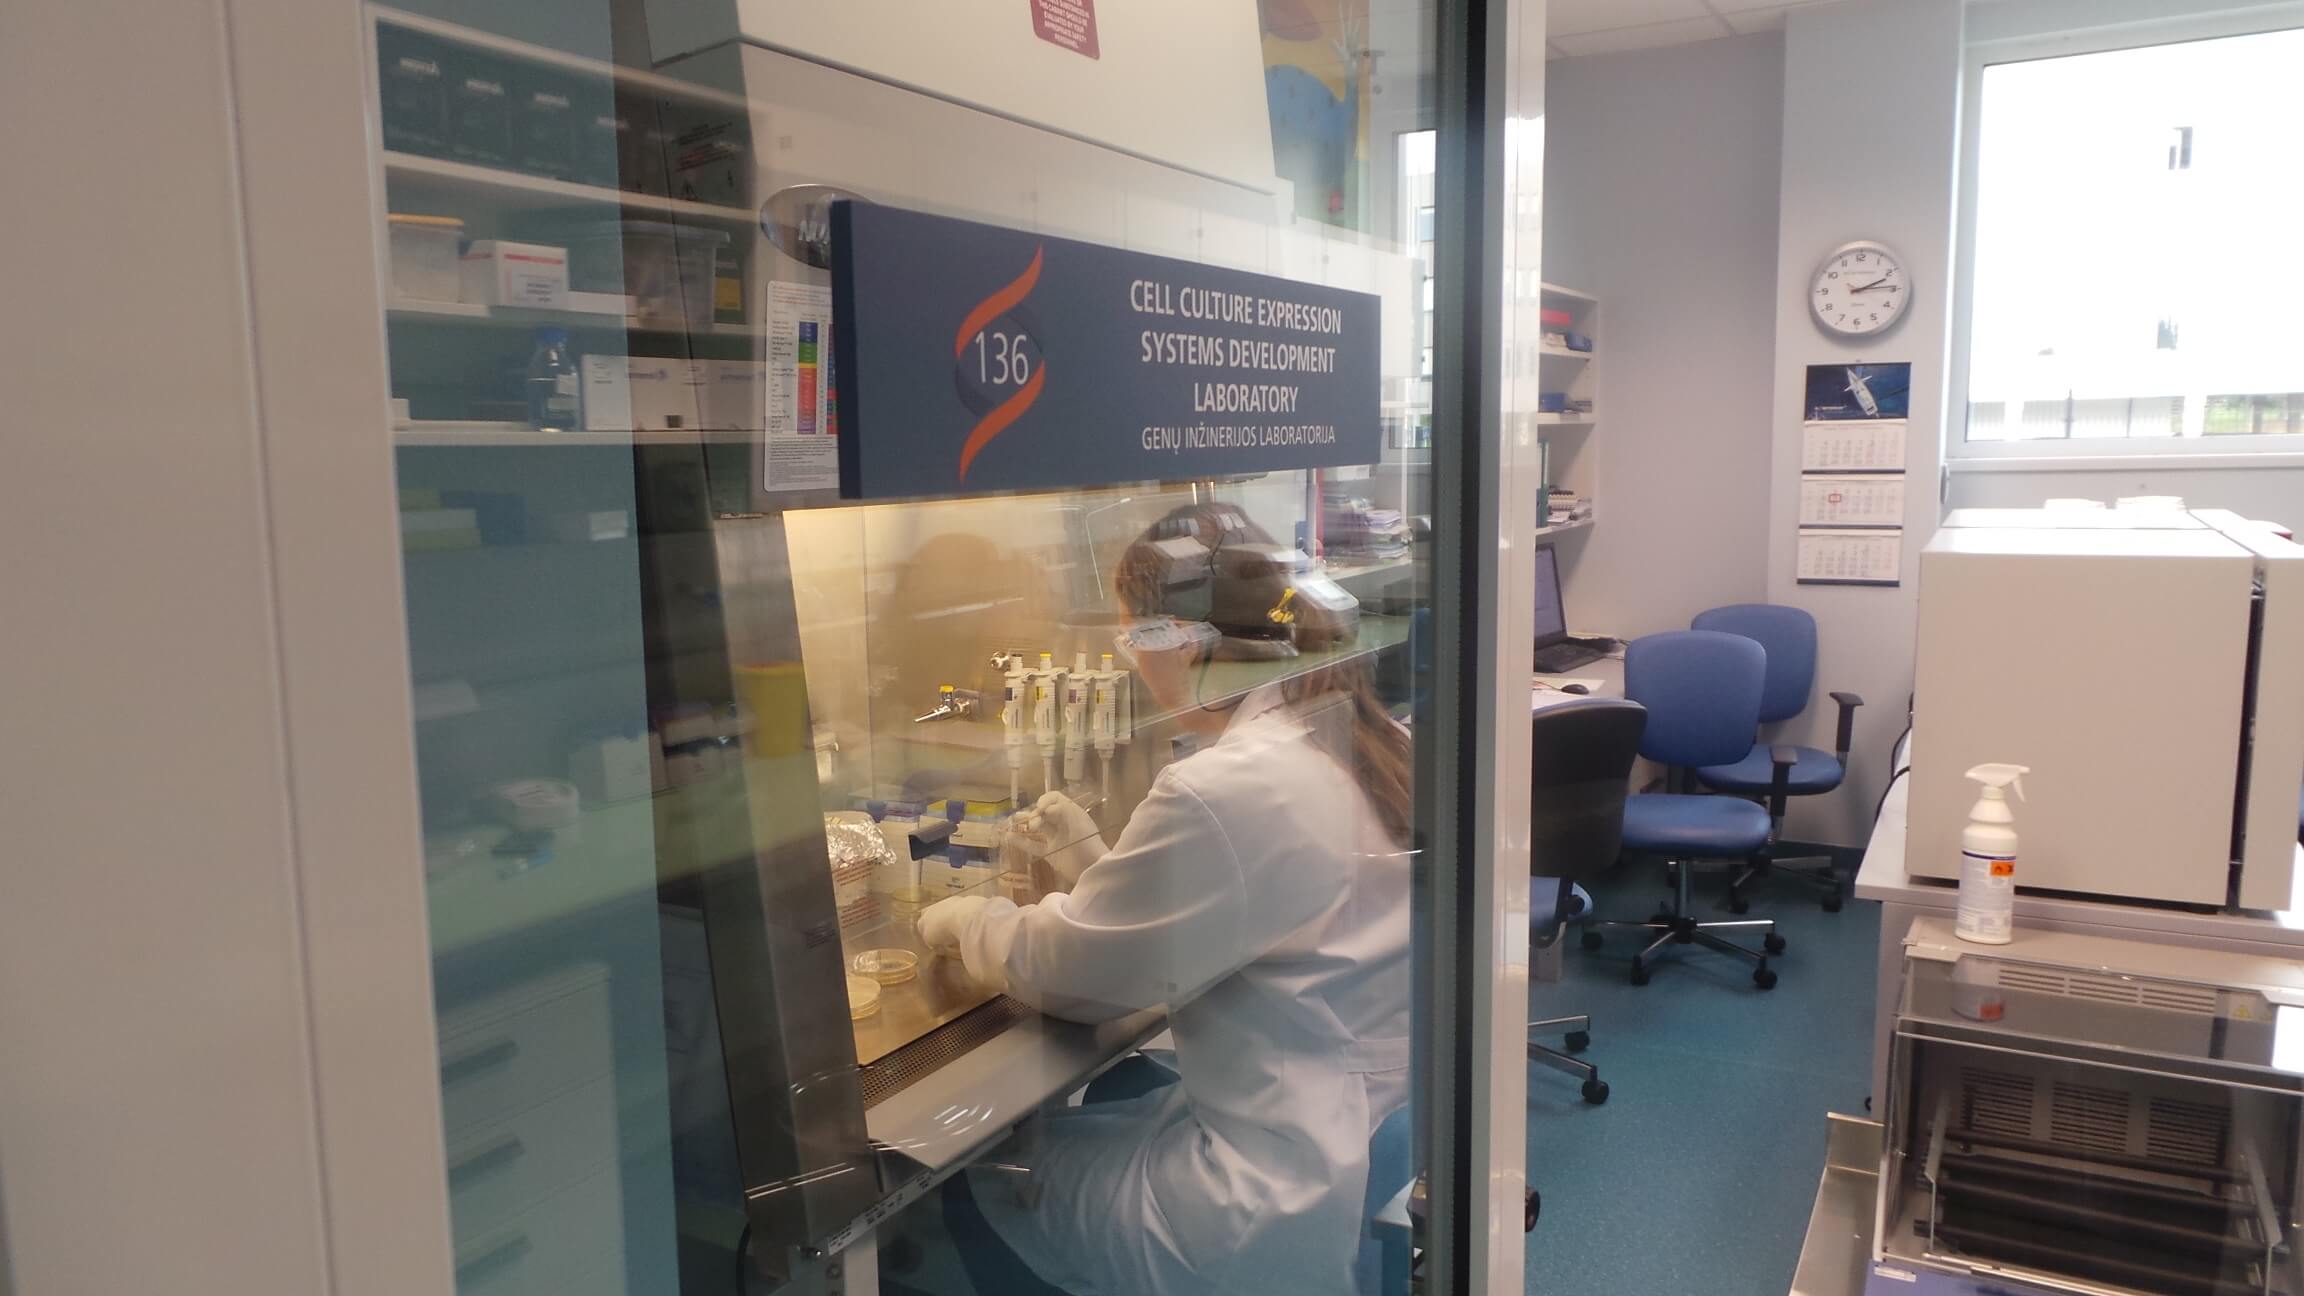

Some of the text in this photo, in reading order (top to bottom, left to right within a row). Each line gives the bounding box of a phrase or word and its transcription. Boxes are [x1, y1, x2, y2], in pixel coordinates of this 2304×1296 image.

[1130, 279, 1342, 335] CELL CULTURE EXPRESSION
[974, 330, 1030, 386] 136
[1141, 330, 1336, 373] SYSTEMS DEVELOPMENT
[1194, 382, 1299, 413] LABORATORY
[1142, 421, 1336, 455] GENŲ INŽINERIJOS LABORATORIJA
